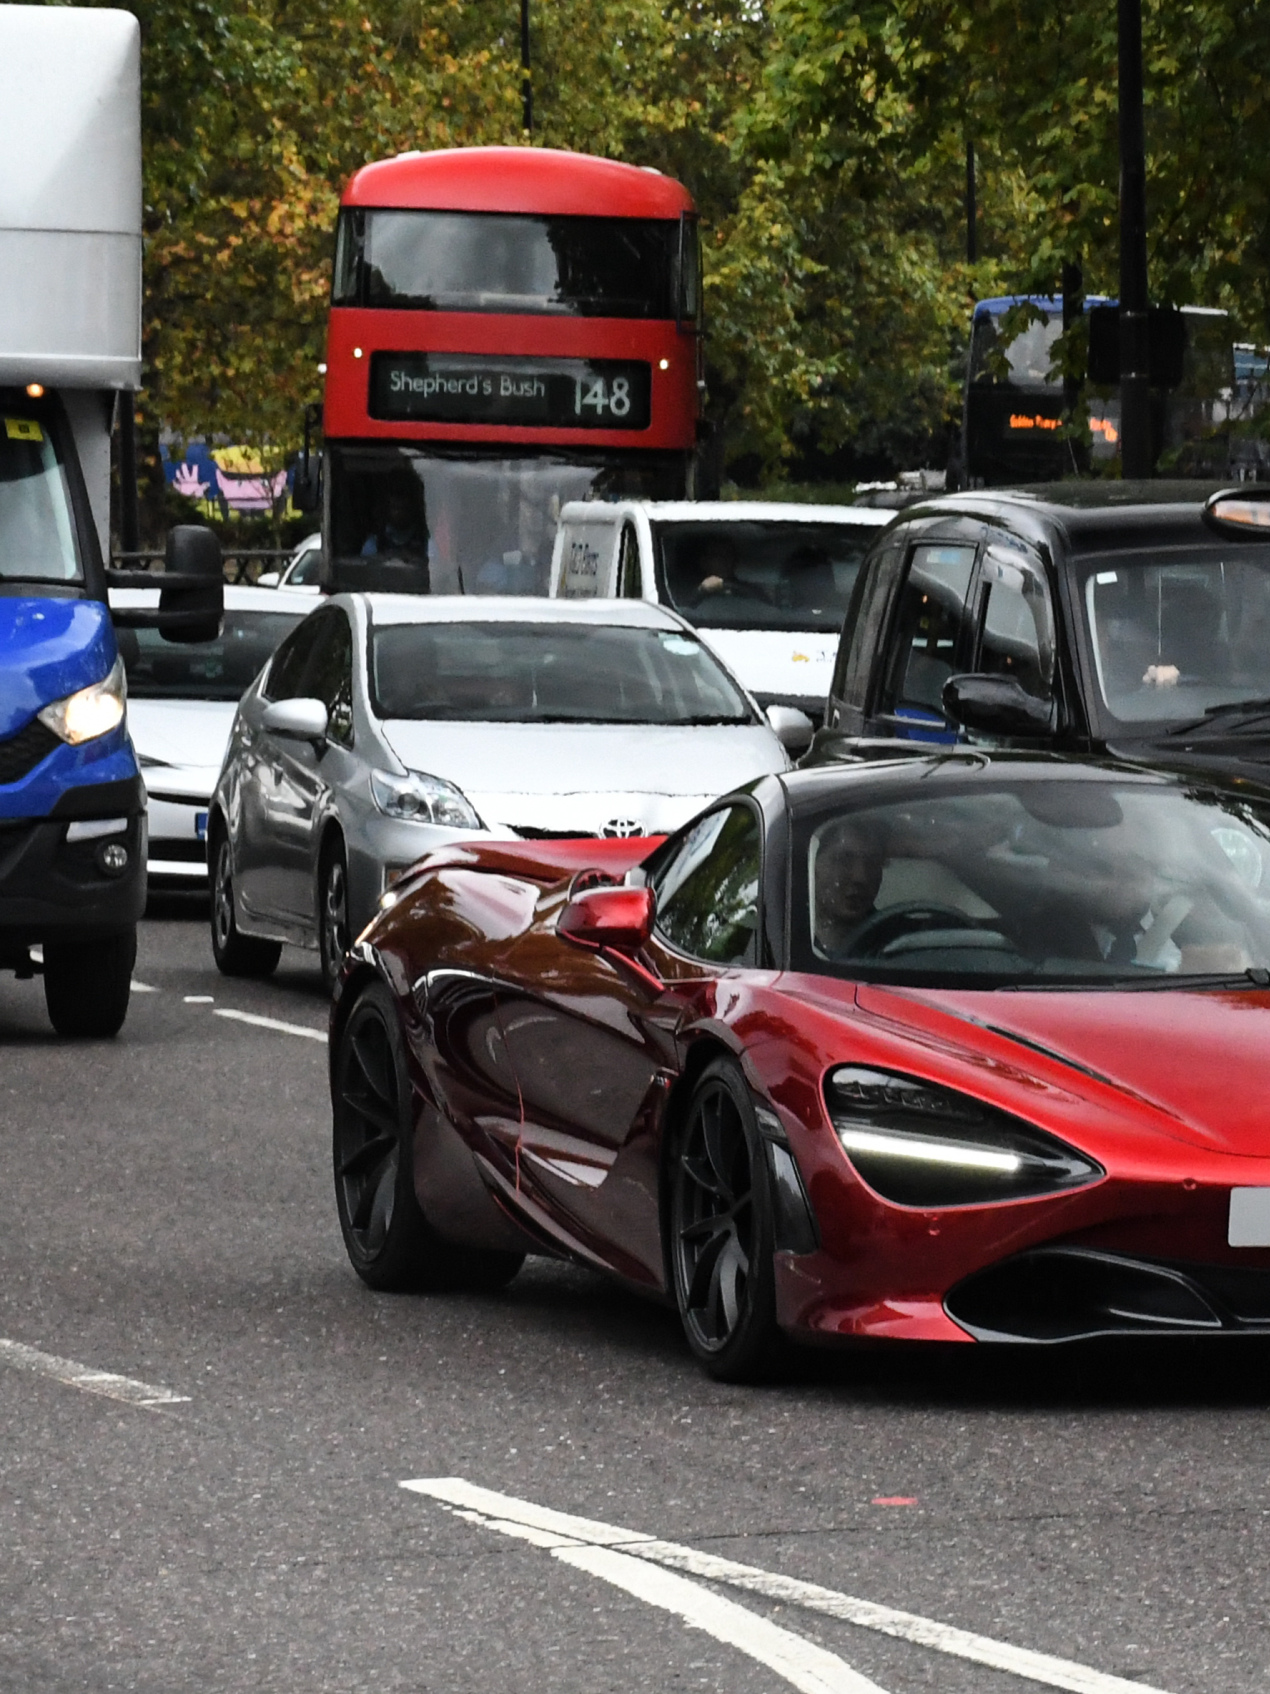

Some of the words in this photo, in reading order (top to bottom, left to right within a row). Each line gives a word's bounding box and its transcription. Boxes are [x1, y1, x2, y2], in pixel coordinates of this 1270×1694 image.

[390, 370, 492, 398] Shepherd's
[500, 375, 546, 398] Bush
[574, 376, 631, 416] 148
